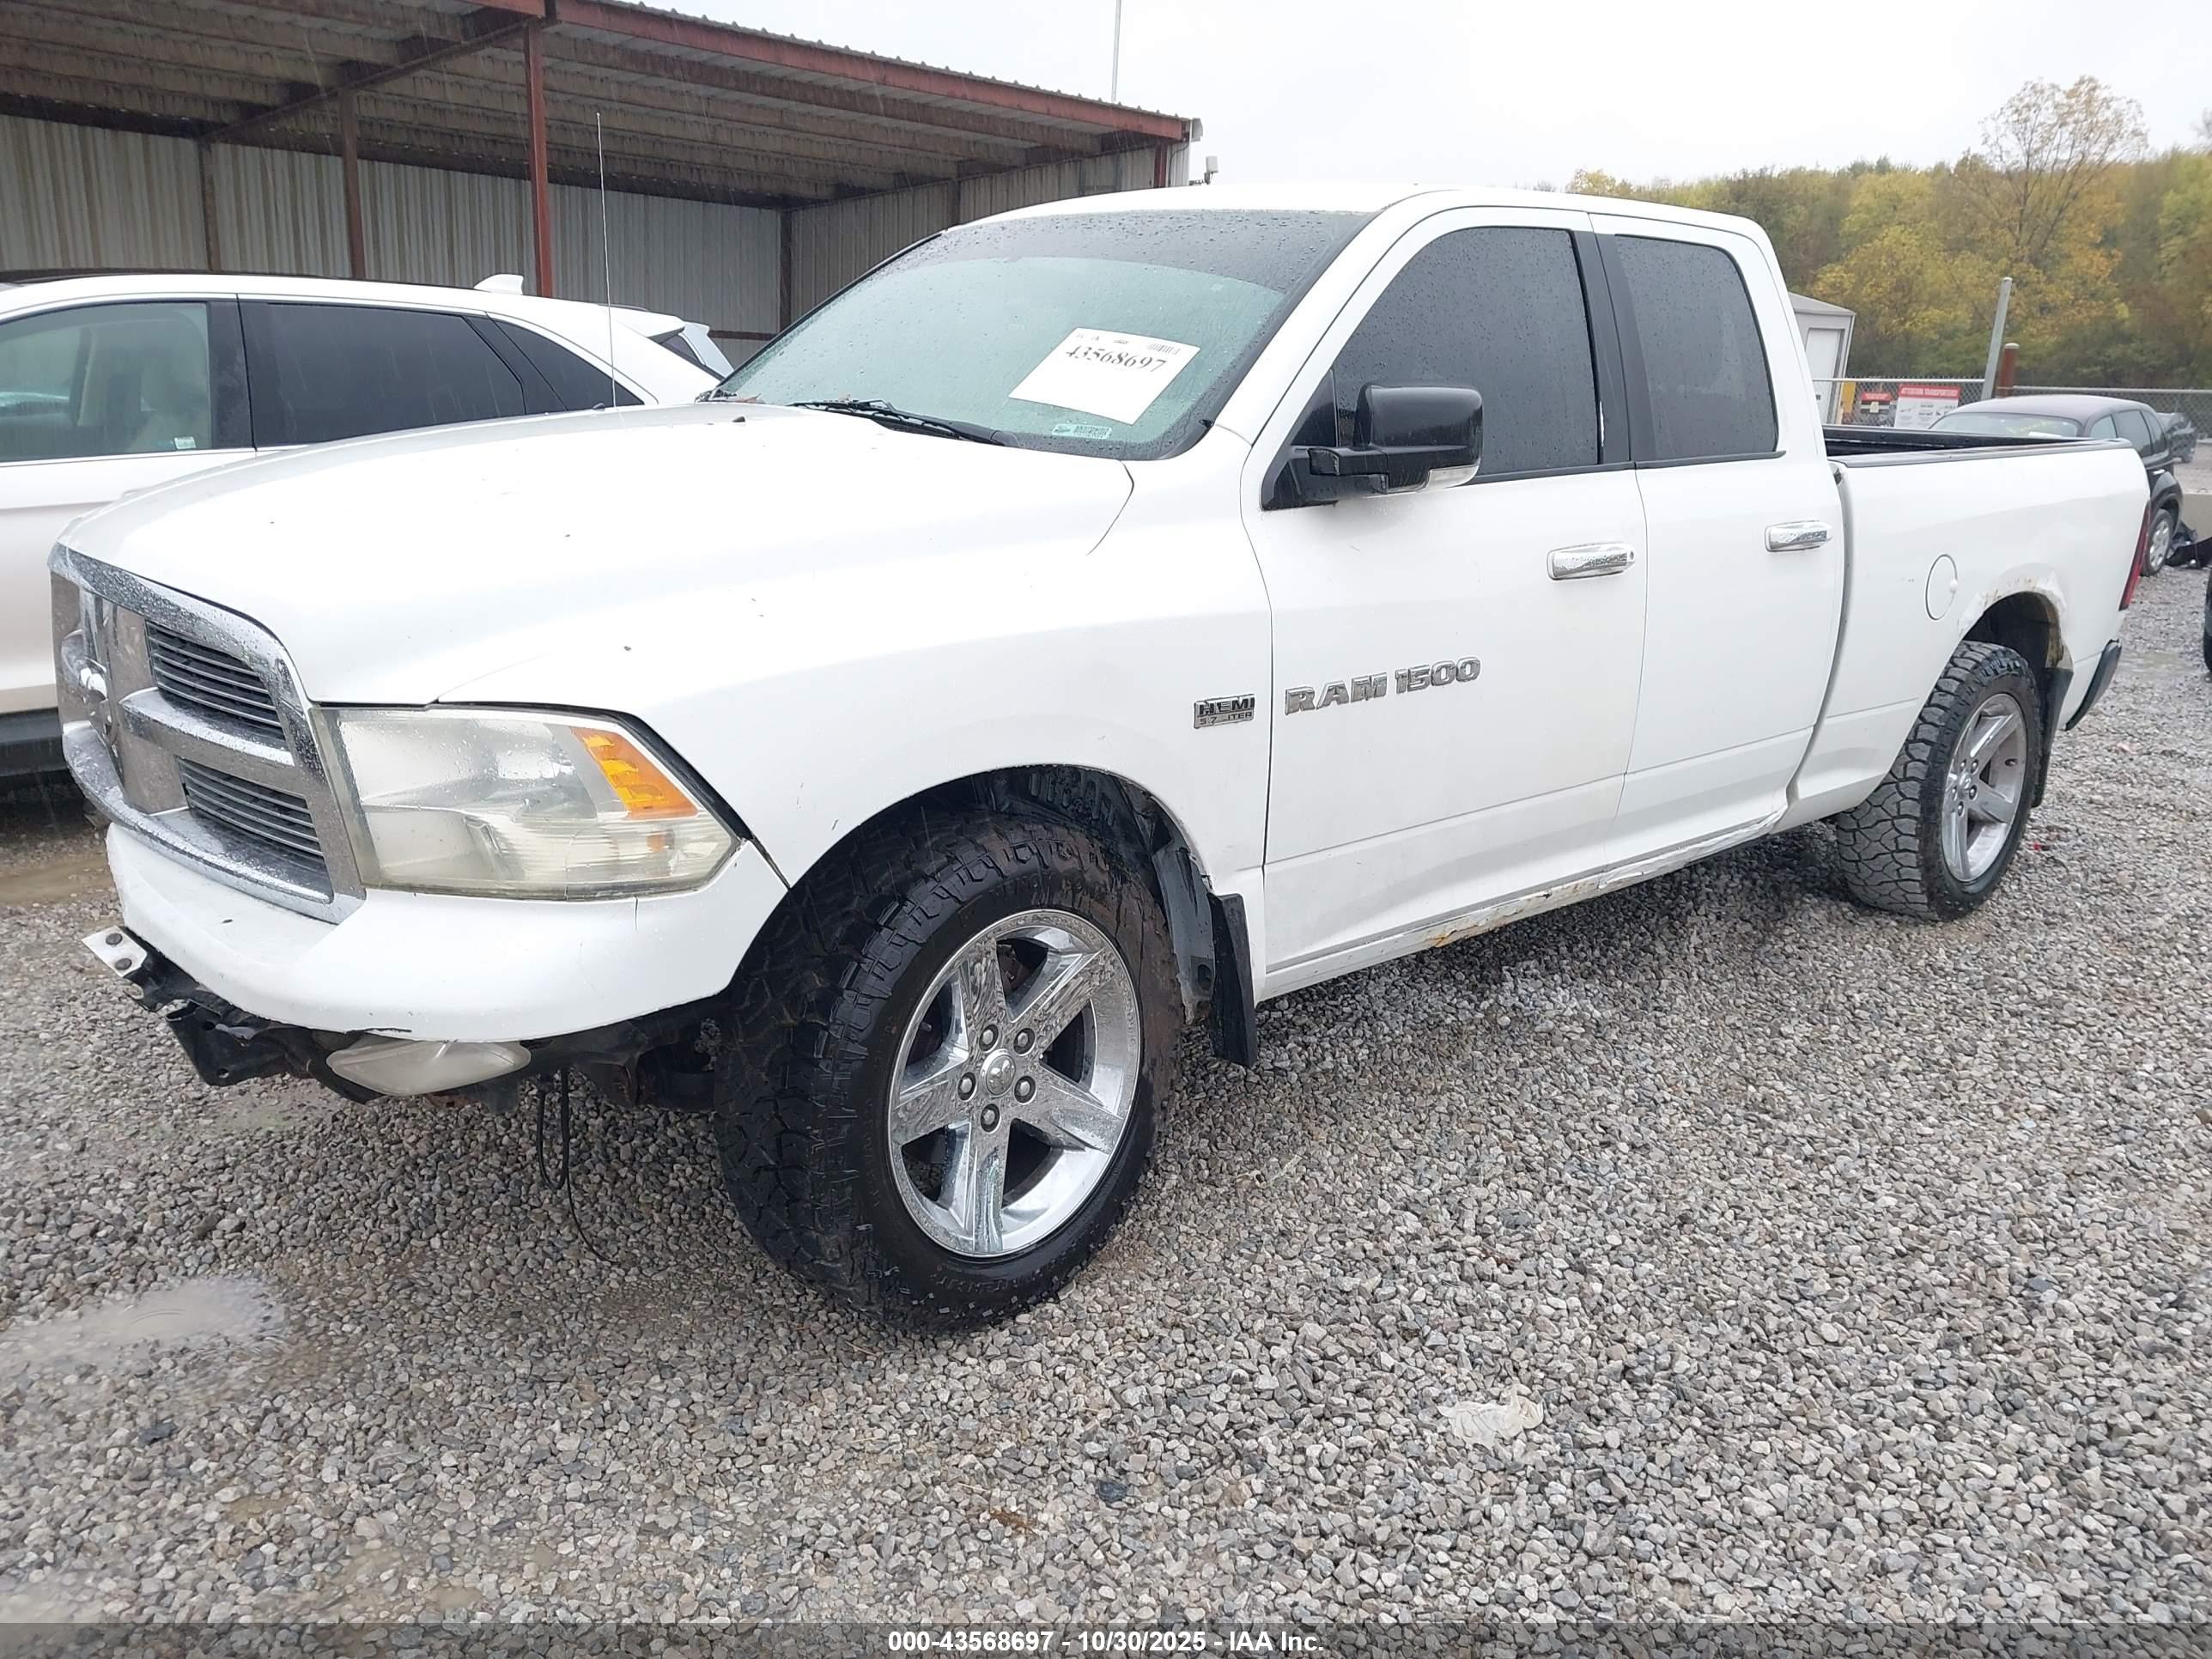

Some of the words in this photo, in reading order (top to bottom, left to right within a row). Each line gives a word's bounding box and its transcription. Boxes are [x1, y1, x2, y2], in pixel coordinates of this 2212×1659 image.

[1066, 345, 1167, 372] 43568697
[1285, 672, 1388, 715] RAM
[1395, 656, 1480, 694] 1500
[1199, 696, 1255, 716] HEMI
